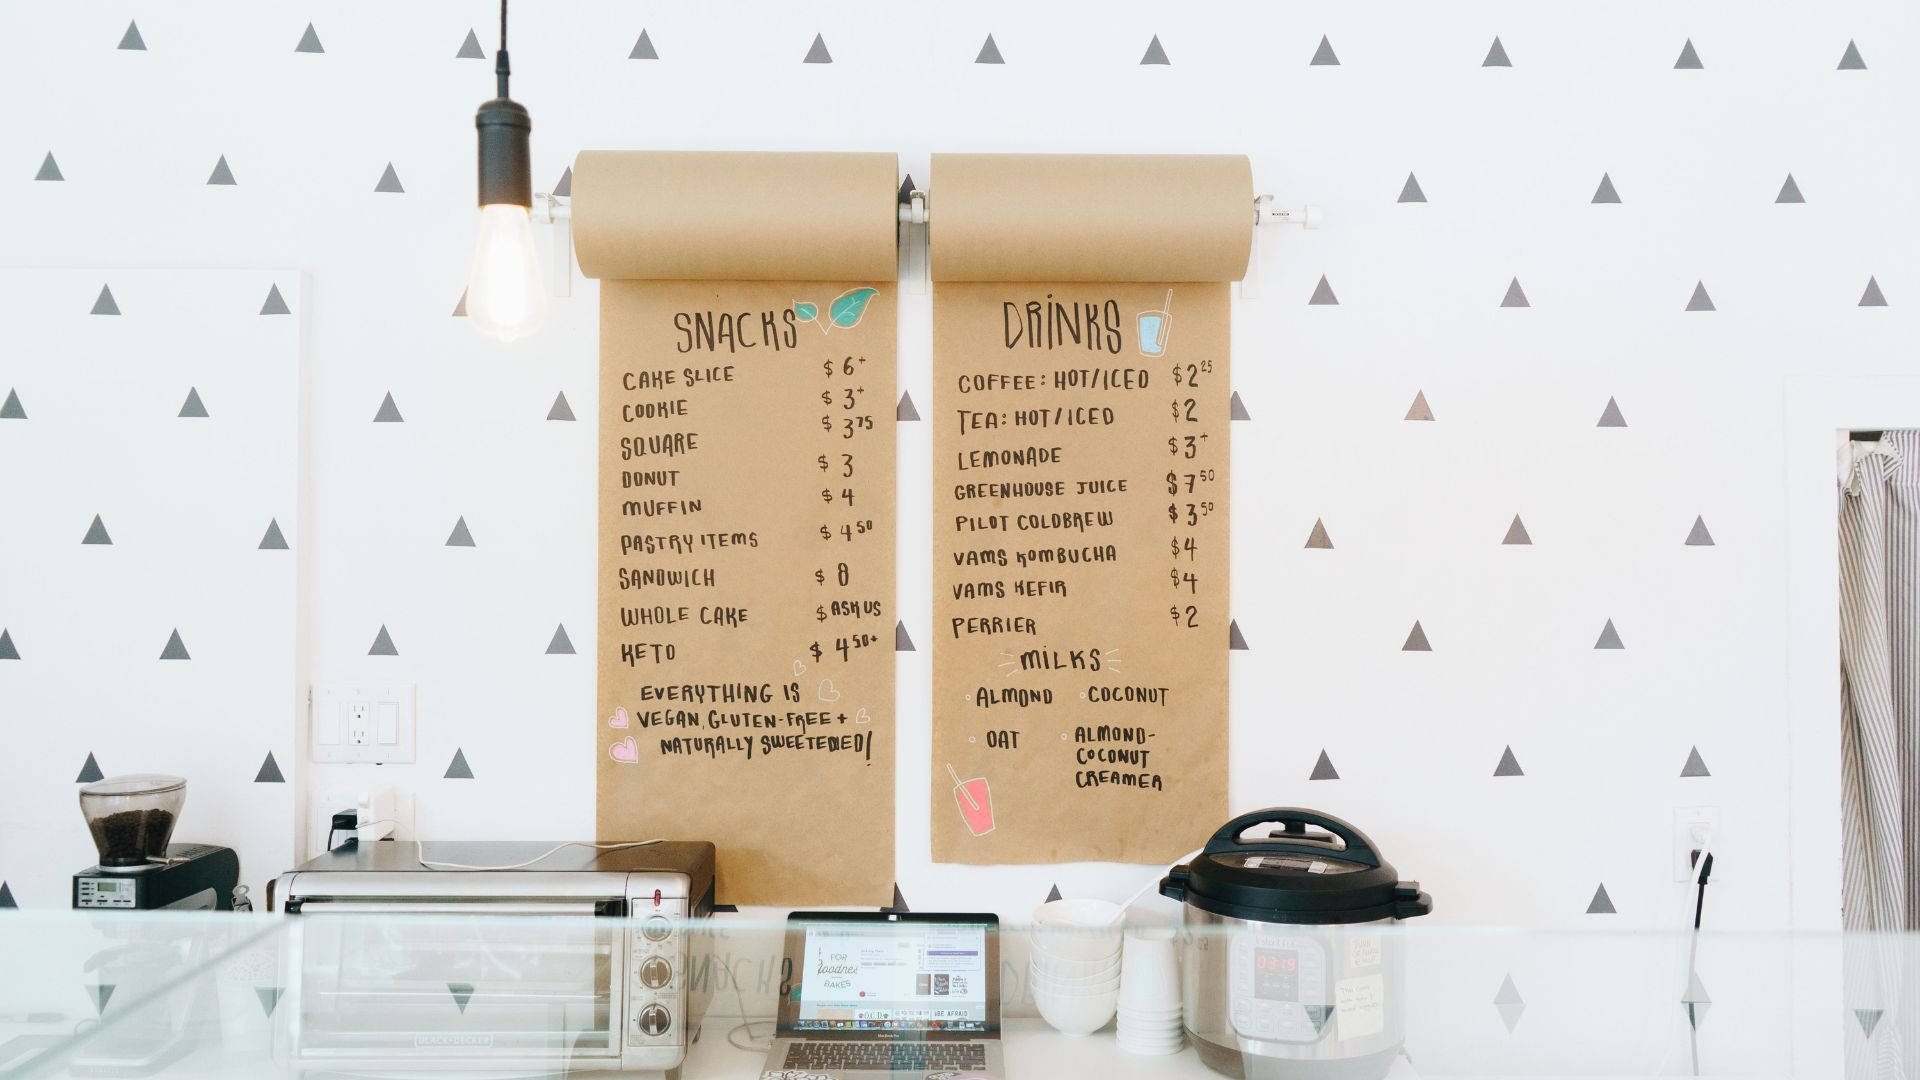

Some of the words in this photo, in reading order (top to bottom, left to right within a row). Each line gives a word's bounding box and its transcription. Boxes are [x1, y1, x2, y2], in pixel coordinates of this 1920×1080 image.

[674, 309, 797, 353] SNACKS
[623, 370, 675, 390] CAKE
[683, 366, 734, 387] SLICE
[959, 374, 1045, 393] COFFEE:
[1055, 368, 1148, 390] HOT/ICED
[623, 400, 688, 422] COOKIE
[957, 410, 1006, 436] TEA:
[1015, 407, 1114, 427] HOT/ICED
[621, 433, 698, 460] SQUARE
[958, 447, 1062, 470] LEMONADE
[622, 471, 680, 488] DONUT
[954, 482, 1064, 500] GREENHOUSE
[1077, 480, 1127, 494] JUICE
[956, 516, 1008, 531] PILOT
[1017, 511, 1113, 532] COLDBREW
[621, 534, 693, 555] PASTRY
[701, 532, 758, 549] ITEMS
[619, 568, 714, 590] SANDWICH
[1015, 580, 1066, 597] KEFIR
[621, 606, 689, 627] WHOLE
[700, 607, 748, 628] CAKE
[864, 601, 881, 616] US
[952, 617, 1036, 639] PERRIER
[621, 643, 675, 667] KETO
[641, 683, 773, 704] EVERYTHING
[783, 682, 800, 702] IS
[977, 687, 1052, 708] ALMOND
[1088, 686, 1169, 706] COCONUT
[708, 710, 831, 734] GLUTEN-FREE
[987, 730, 1020, 749] OAT
[1075, 725, 1155, 744] ALMOND-
[661, 736, 753, 760] NATURALLY
[1077, 748, 1150, 768] COCONUT
[1076, 770, 1162, 791] CREAMER
